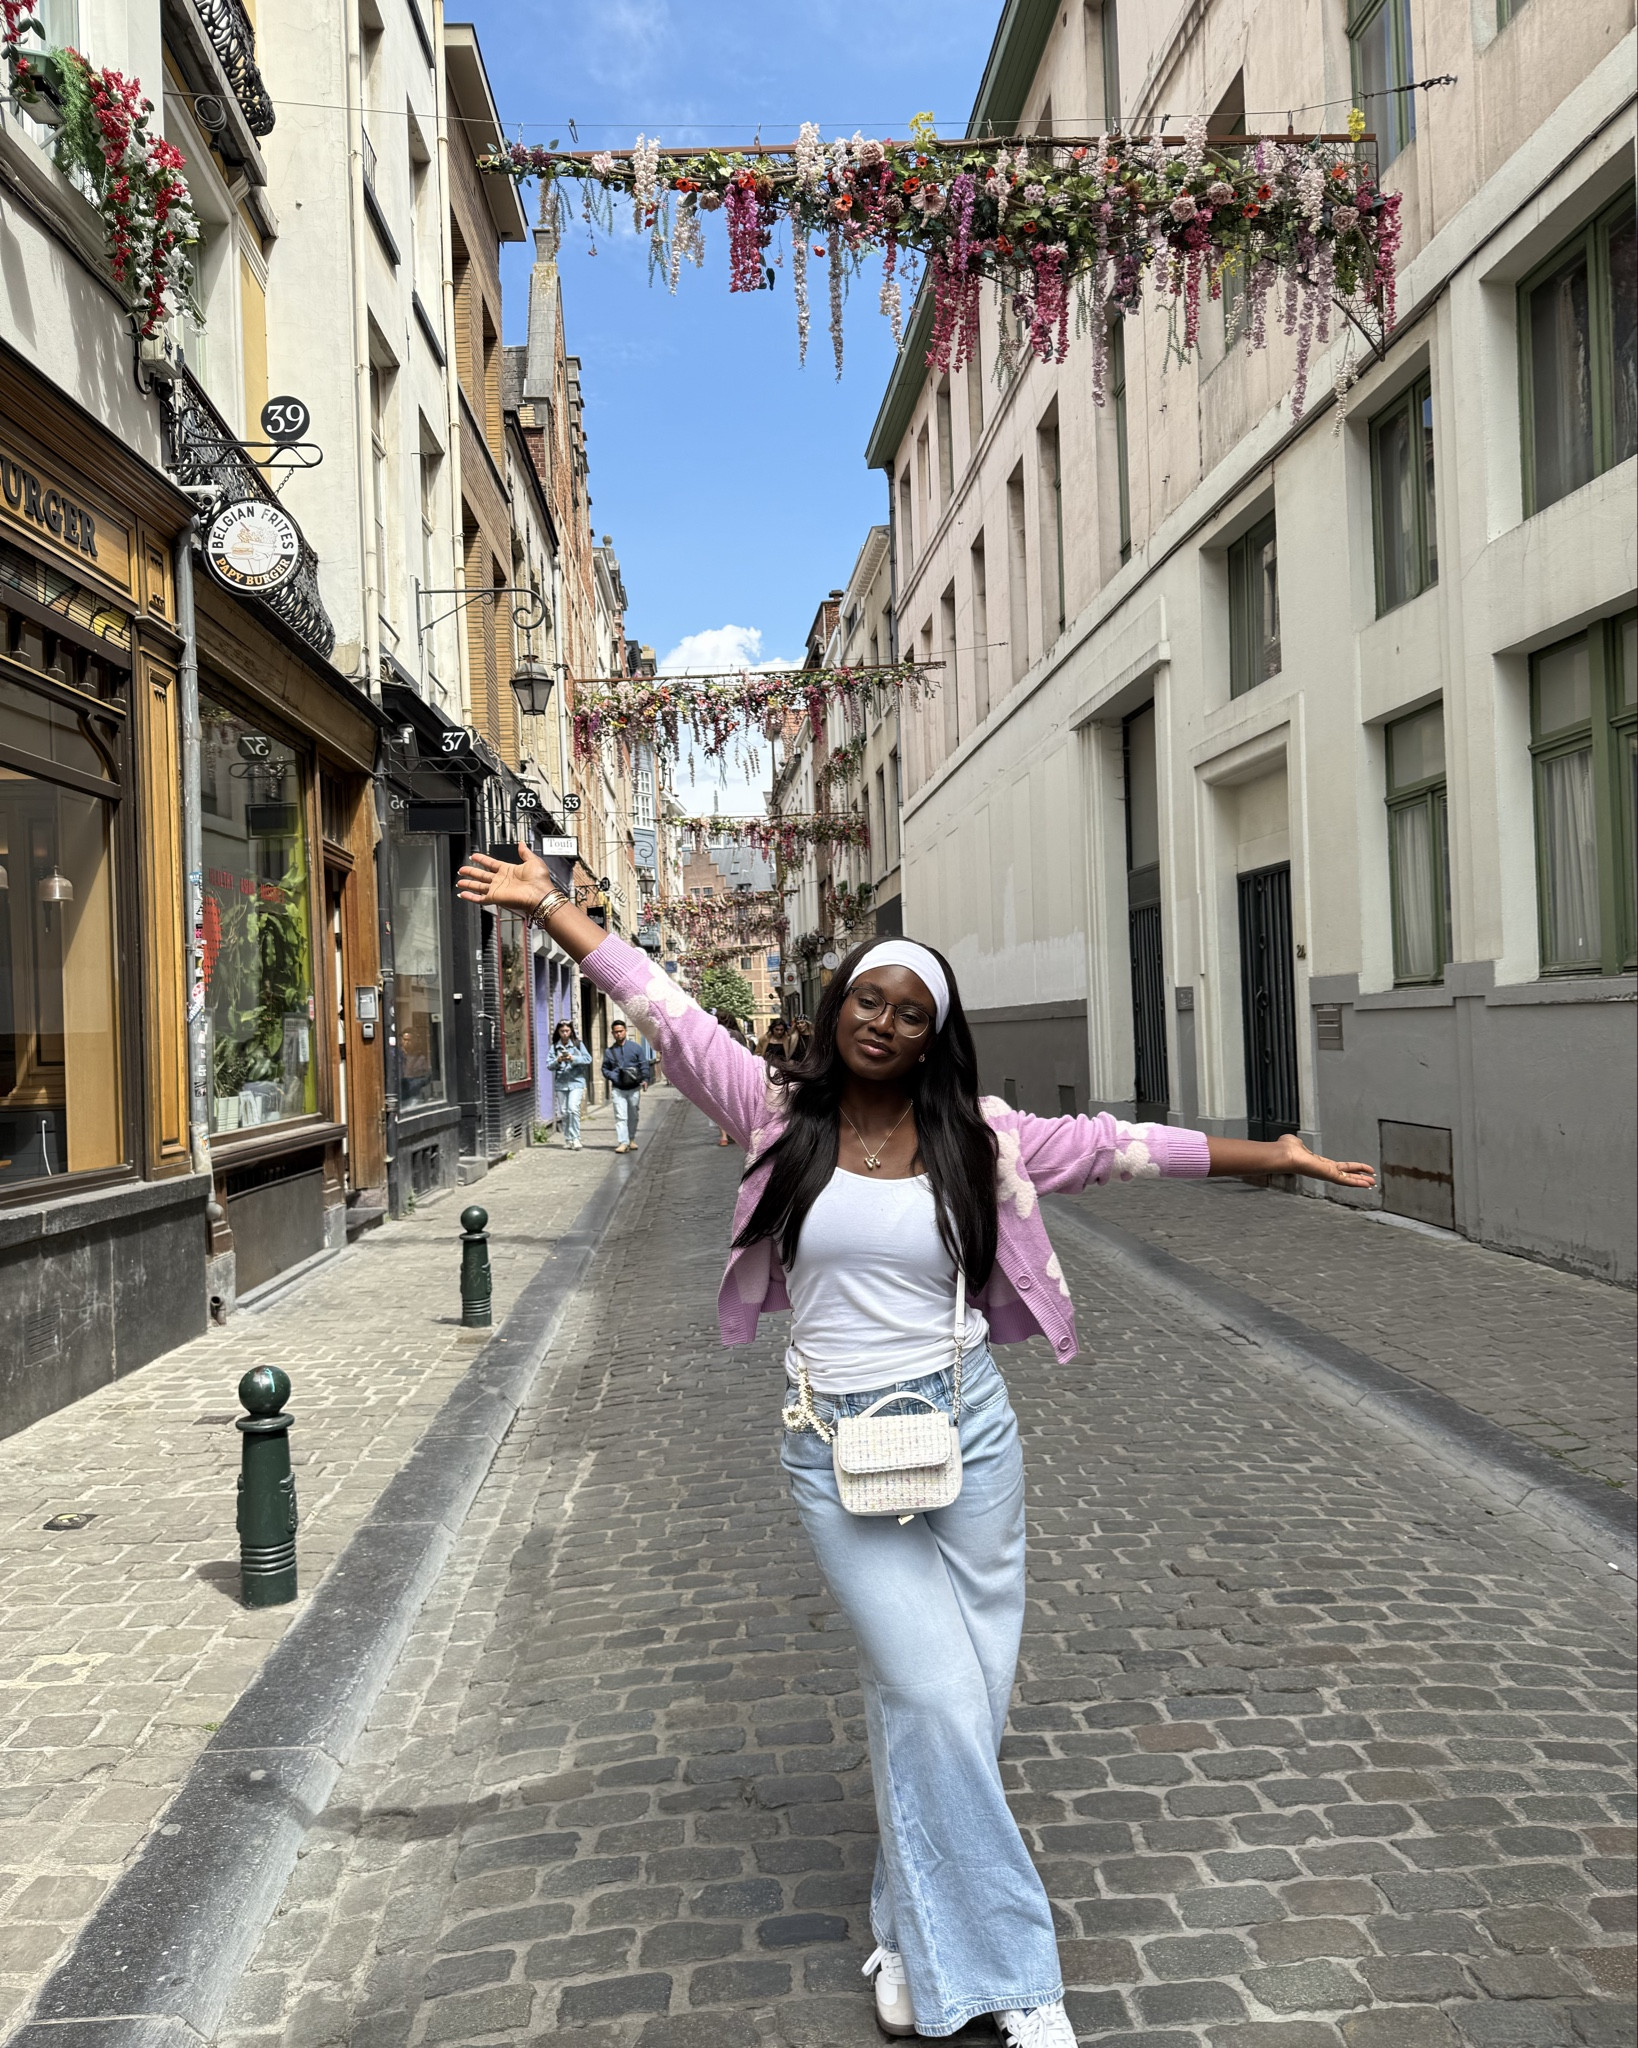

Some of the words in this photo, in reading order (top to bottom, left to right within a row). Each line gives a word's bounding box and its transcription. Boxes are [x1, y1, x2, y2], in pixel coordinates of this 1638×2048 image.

[266, 404, 305, 434] 39
[0, 454, 98, 557] URGER
[212, 506, 255, 549] BELGIAN
[261, 507, 294, 550] FRITES
[216, 557, 244, 583] PAPY
[246, 558, 291, 586] BURGER
[441, 731, 466, 752] 37
[516, 792, 537, 808] 35
[563, 796, 579, 809] 33
[846, 919, 855, 928] 20
[1296, 944, 1306, 960] 24
